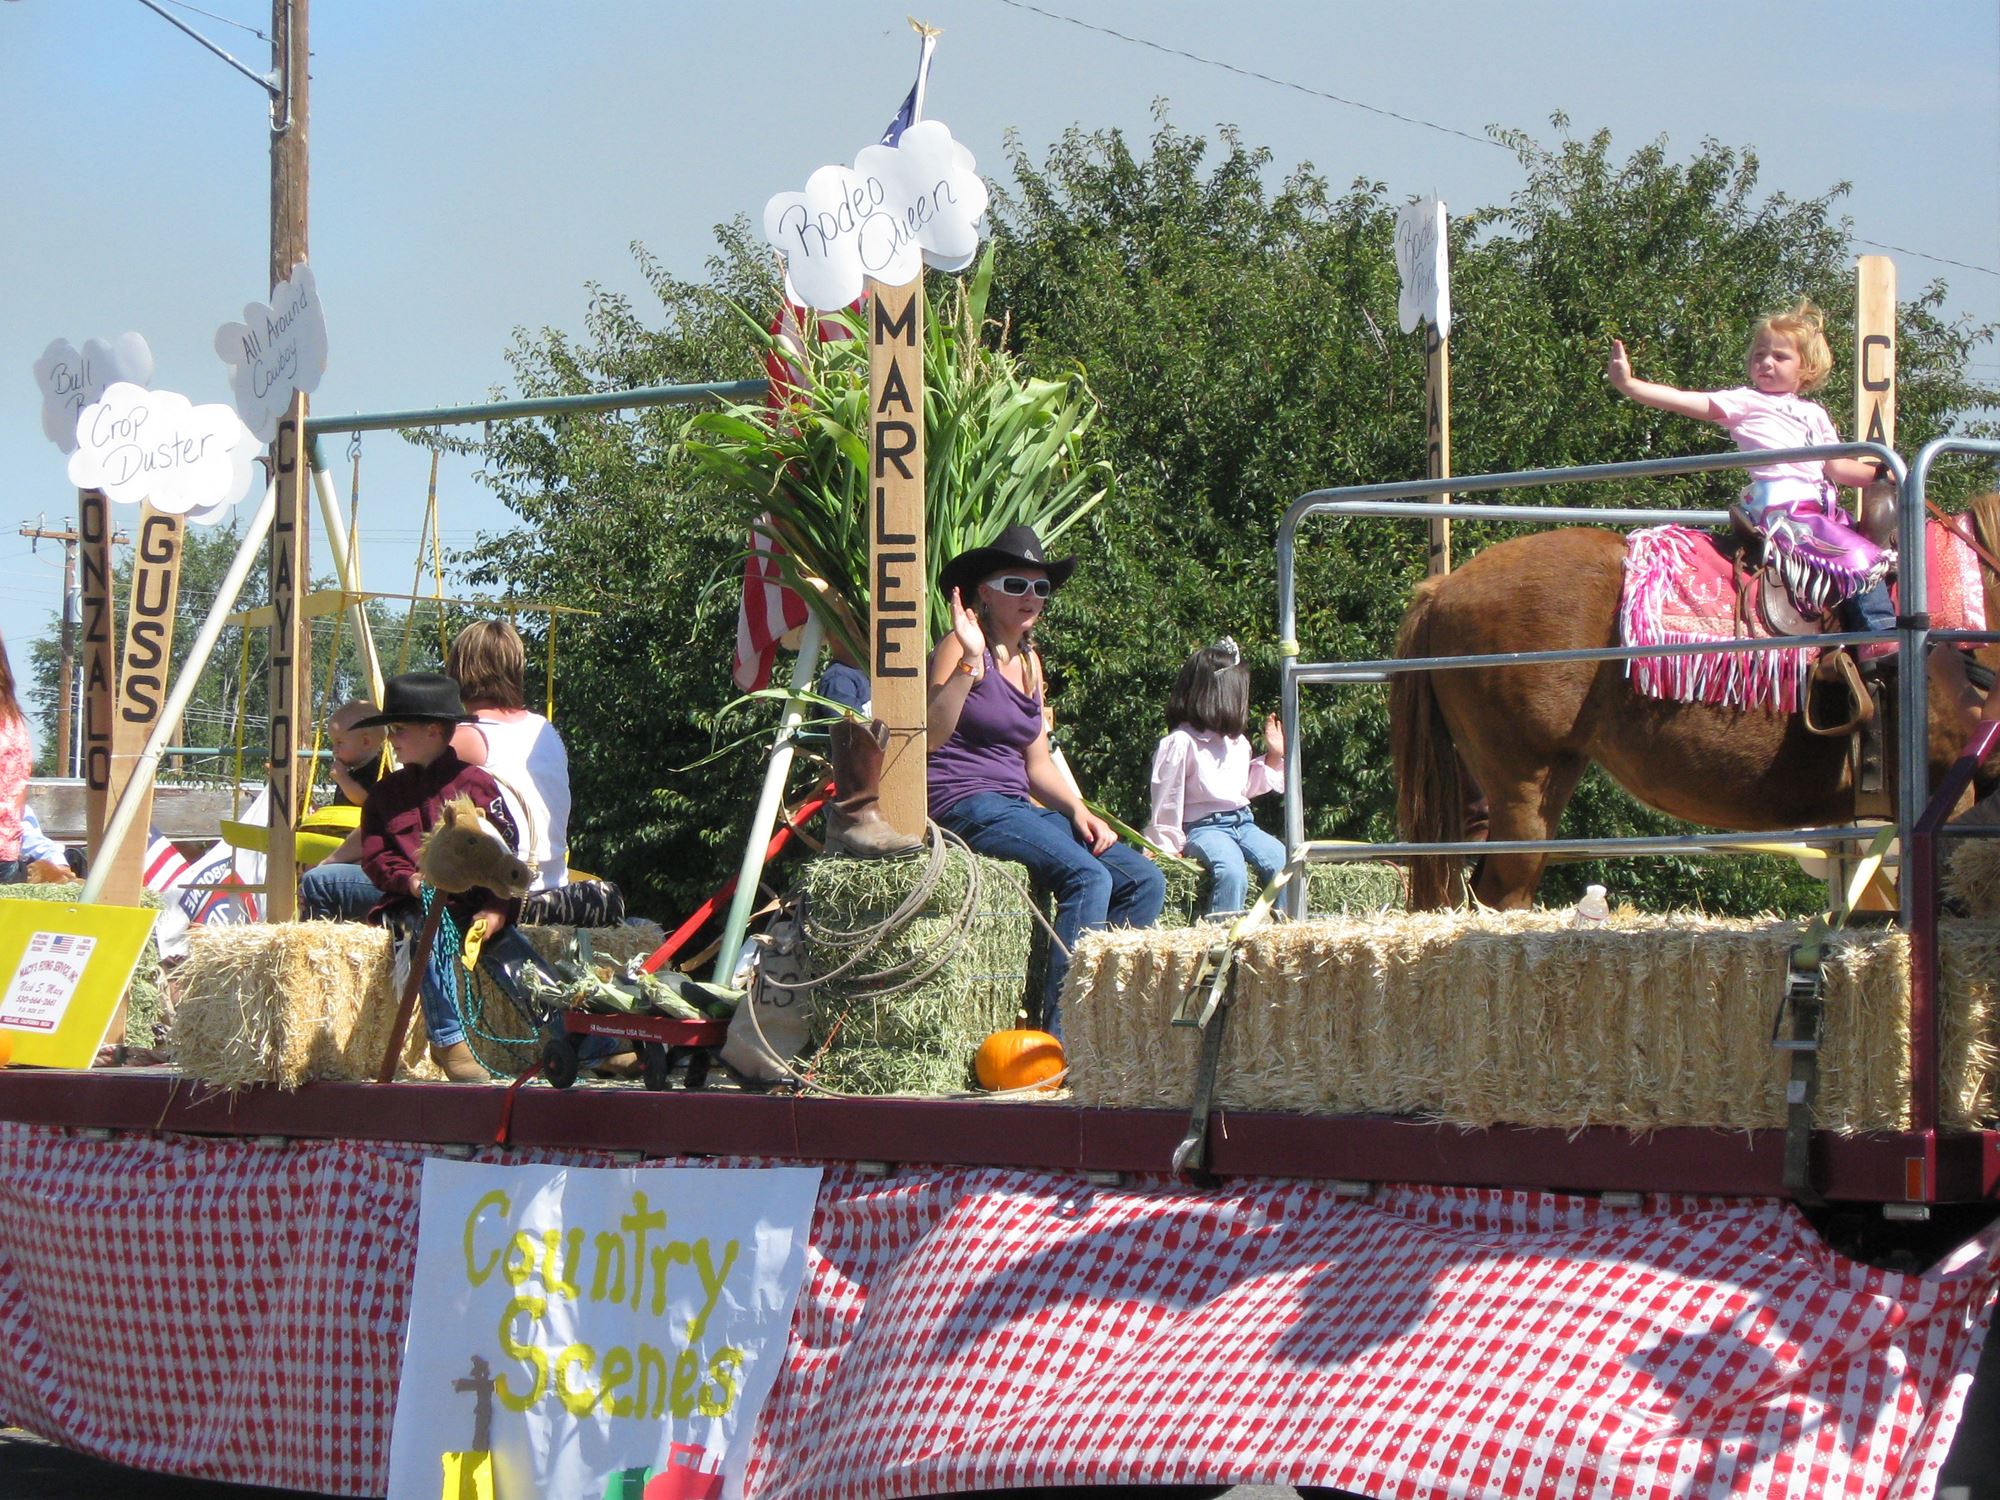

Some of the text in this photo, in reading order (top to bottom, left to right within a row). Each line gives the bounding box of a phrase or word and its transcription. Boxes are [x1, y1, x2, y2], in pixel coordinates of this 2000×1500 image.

[779, 176, 884, 257] Rodeo
[858, 180, 957, 270] Queen
[242, 283, 309, 364] All Around
[50, 359, 93, 395] Bull
[252, 342, 298, 398] Cowboy
[1862, 334, 1892, 466] CA
[91, 404, 149, 448] Crop
[102, 431, 214, 486] Duster
[874, 292, 919, 678] MARLEE
[81, 487, 111, 791] ONZALO
[122, 515, 176, 723] GUSS
[269, 419, 297, 828] CLAYTON
[626, 1028, 638, 1036] USA
[463, 1189, 739, 1352] Country
[493, 1295, 744, 1420] Scenes
